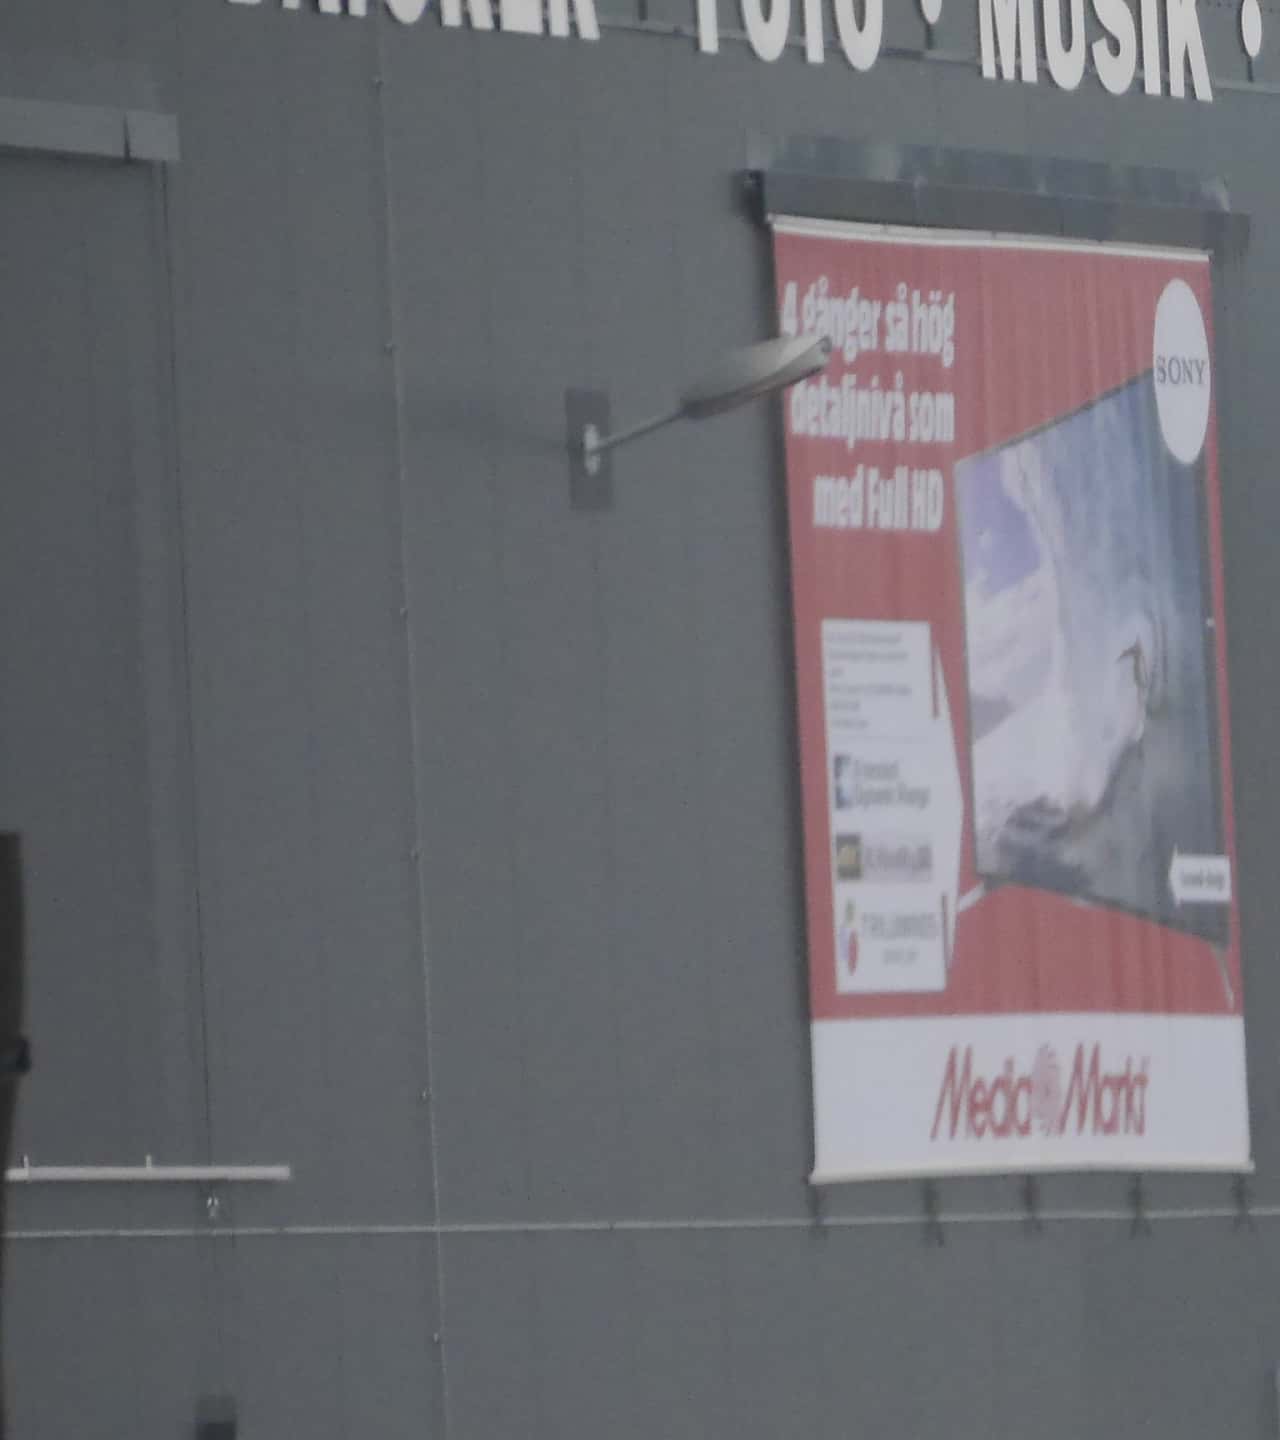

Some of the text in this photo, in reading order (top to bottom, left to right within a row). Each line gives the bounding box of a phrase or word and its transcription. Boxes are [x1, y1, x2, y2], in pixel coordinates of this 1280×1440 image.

[802, 275, 882, 363] gånger
[885, 281, 910, 353] så
[911, 289, 956, 369] hög
[1157, 355, 1206, 385] SONY
[790, 371, 956, 454] detaljnivå som
[813, 463, 945, 532] med Full HD
